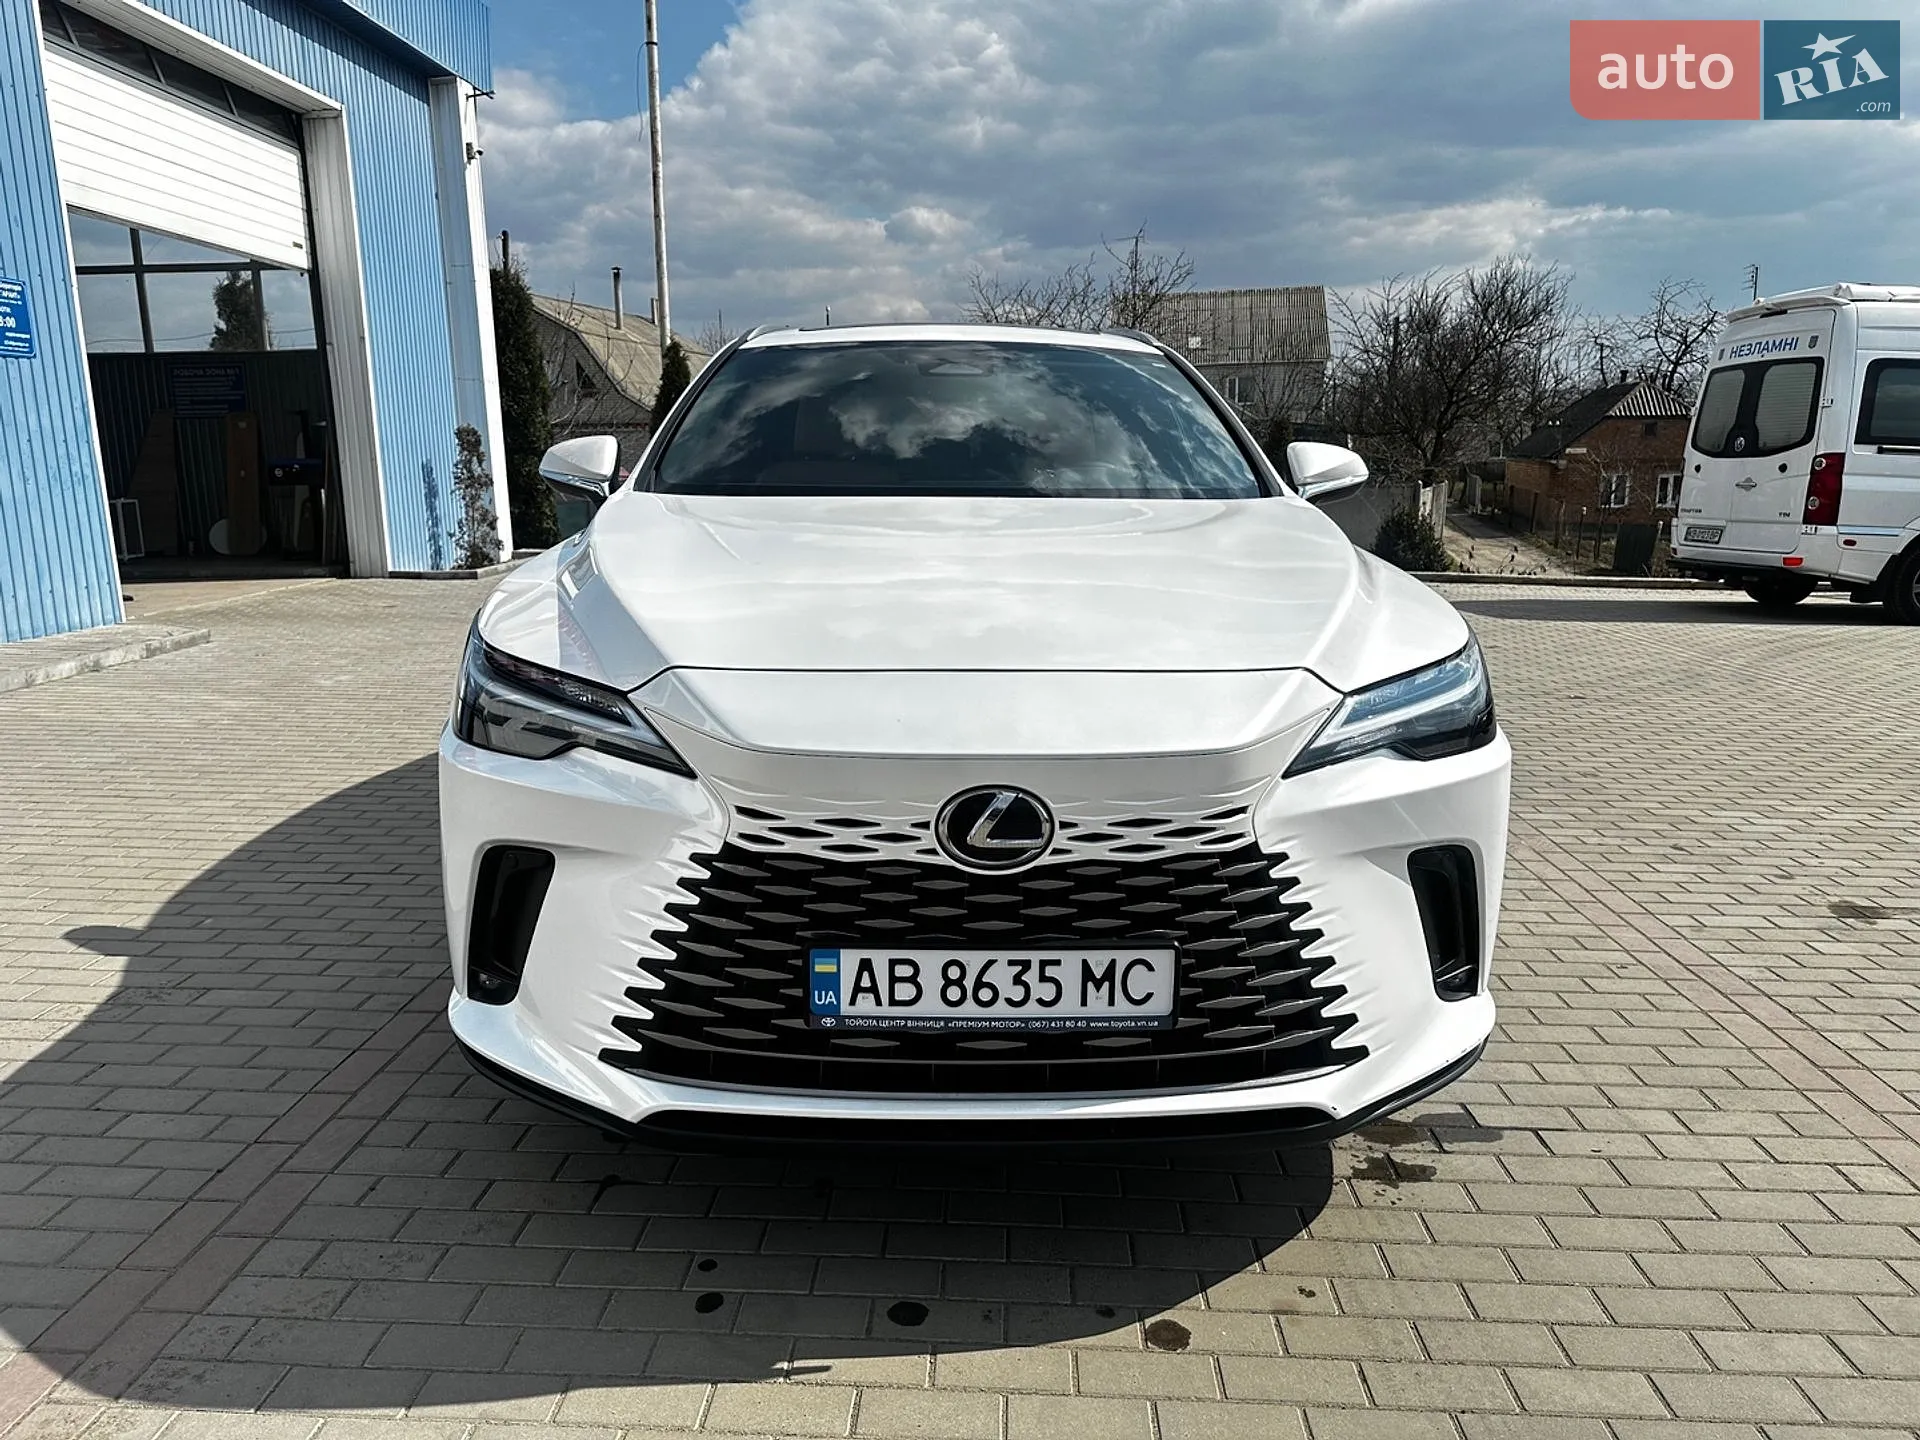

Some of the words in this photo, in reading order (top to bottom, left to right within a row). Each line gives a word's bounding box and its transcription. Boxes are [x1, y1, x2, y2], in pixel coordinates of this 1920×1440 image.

[1729, 336, 1800, 359] НЕЗЛАМНІ
[848, 957, 924, 1007] AB
[939, 957, 1064, 1008] 8635
[1079, 957, 1157, 1007] MC
[814, 990, 837, 1005] UA
[844, 1017, 877, 1027] ТОЙОТА
[878, 1018, 905, 1028] ЦЕНТР
[906, 1018, 945, 1028] ВІННИЦЯ
[1028, 1020, 1049, 1029] (067)
[1050, 1020, 1064, 1028] 431
[1065, 1020, 1076, 1028] 80
[1076, 1020, 1087, 1028] 40
